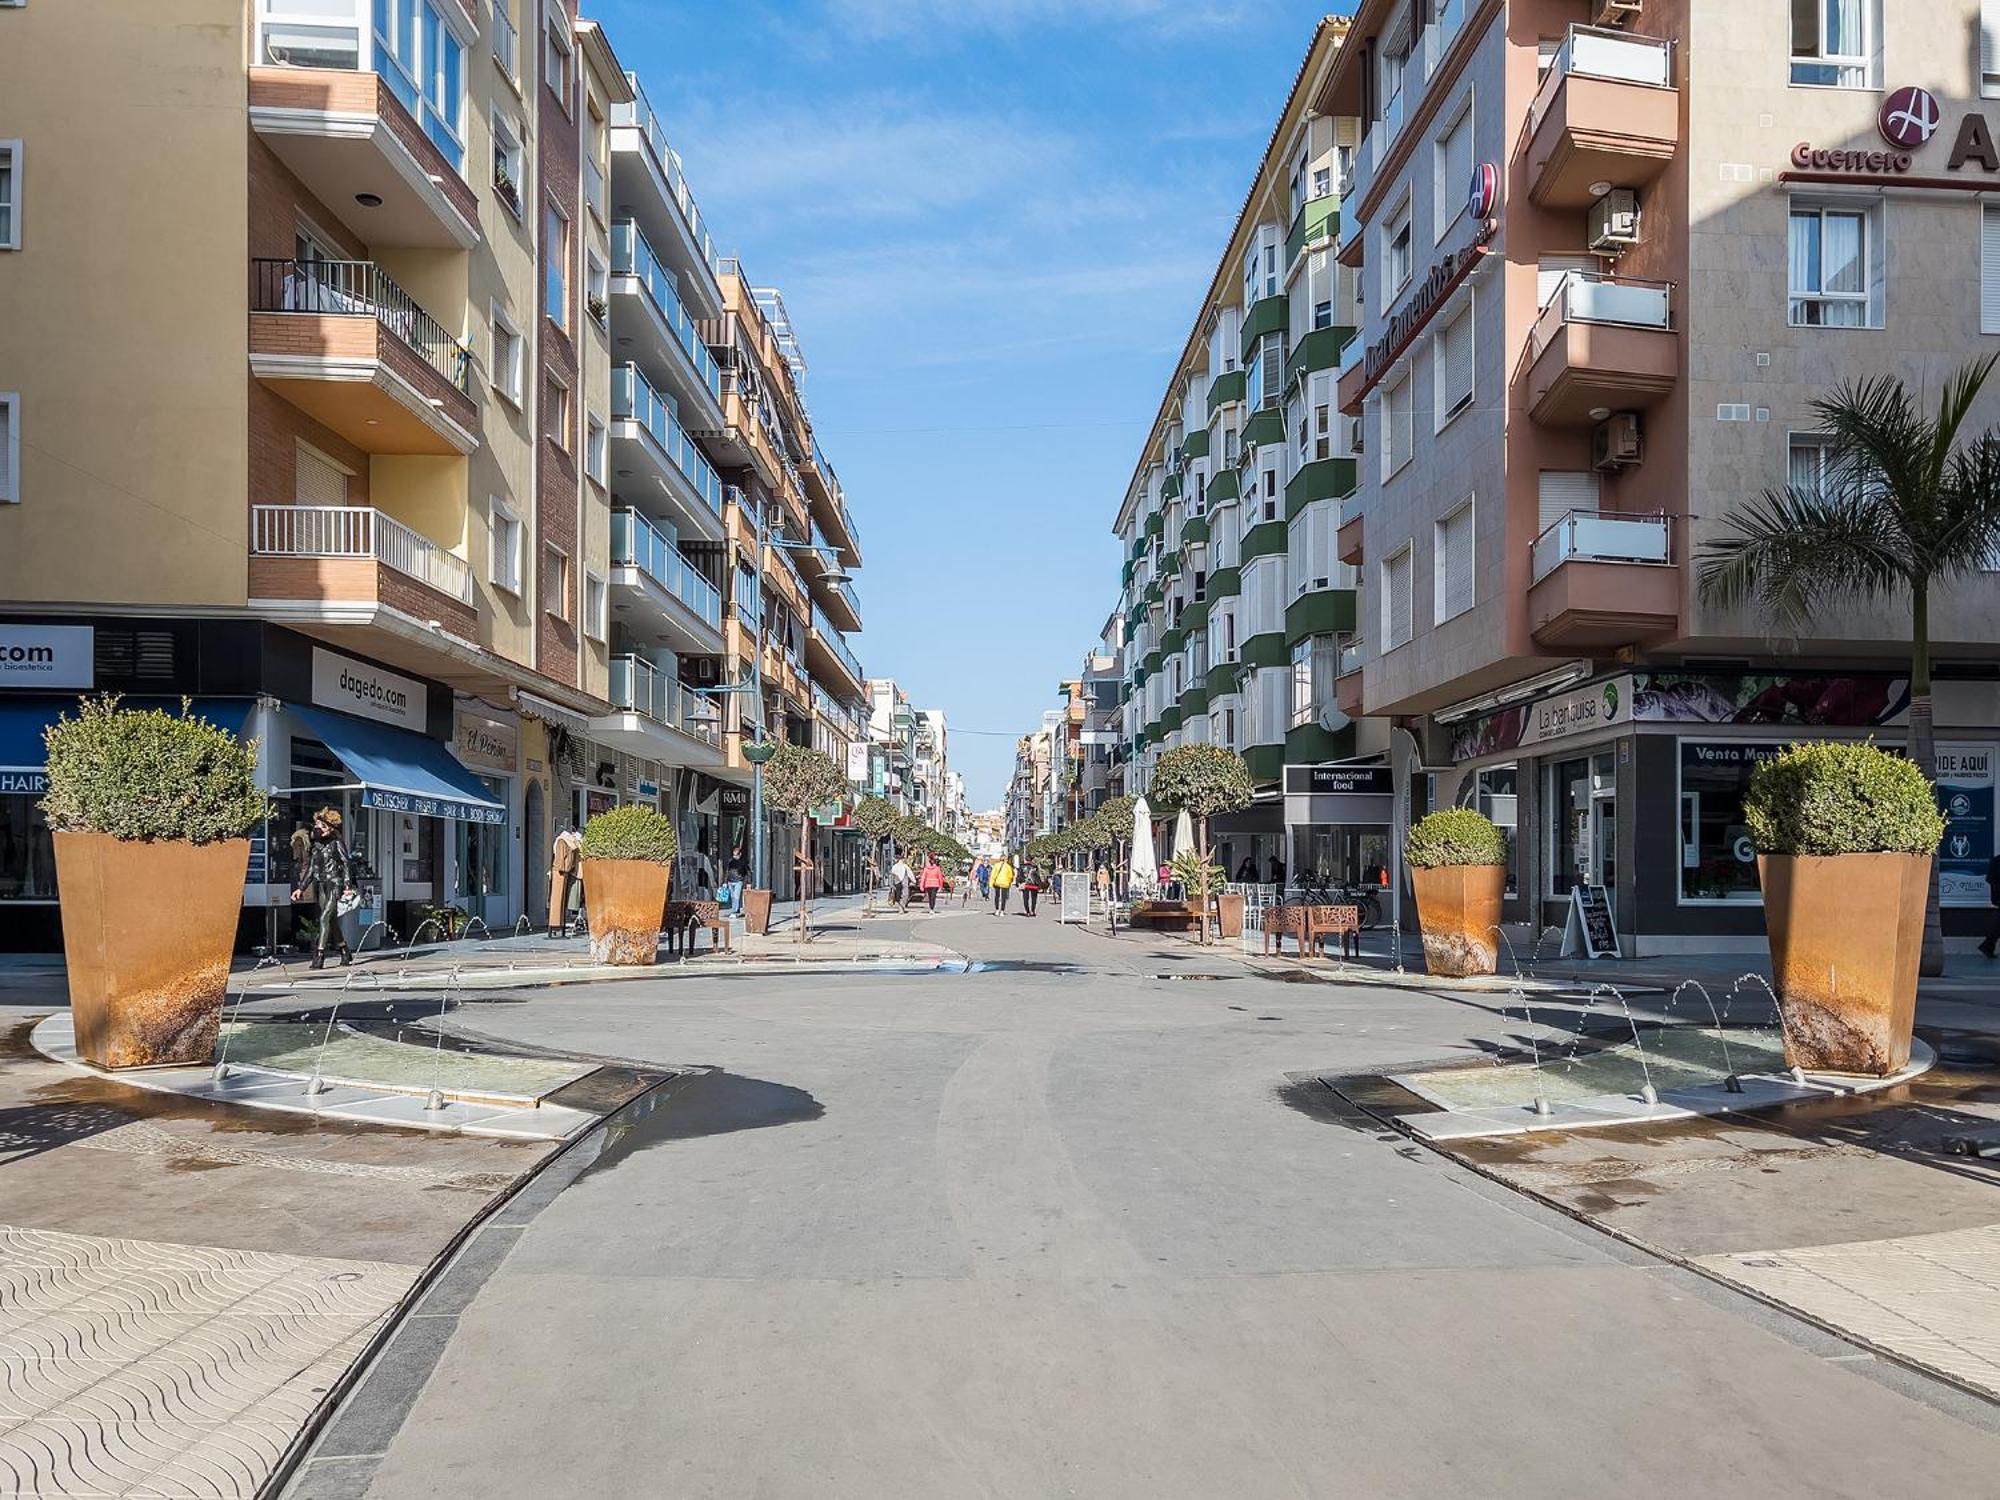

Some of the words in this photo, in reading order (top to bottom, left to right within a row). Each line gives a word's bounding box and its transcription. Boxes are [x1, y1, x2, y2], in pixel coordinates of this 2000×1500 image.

[1791, 142, 1913, 173] Guerrero
[1946, 112, 2000, 171] A
[1365, 253, 1454, 383] Apartamentos
[339, 667, 406, 708] dagedo.com
[1539, 708, 1550, 731] La
[467, 729, 479, 753] El
[1696, 746, 1740, 760] Venta
[1744, 747, 1781, 761] Mayo
[1936, 755, 1957, 771] IDE
[1960, 752, 1989, 771] AQUÍ
[1, 775, 45, 790] HAIR
[1314, 771, 1373, 781] Internacional
[1333, 780, 1354, 790] food
[372, 791, 409, 810] DEUTSCHER
